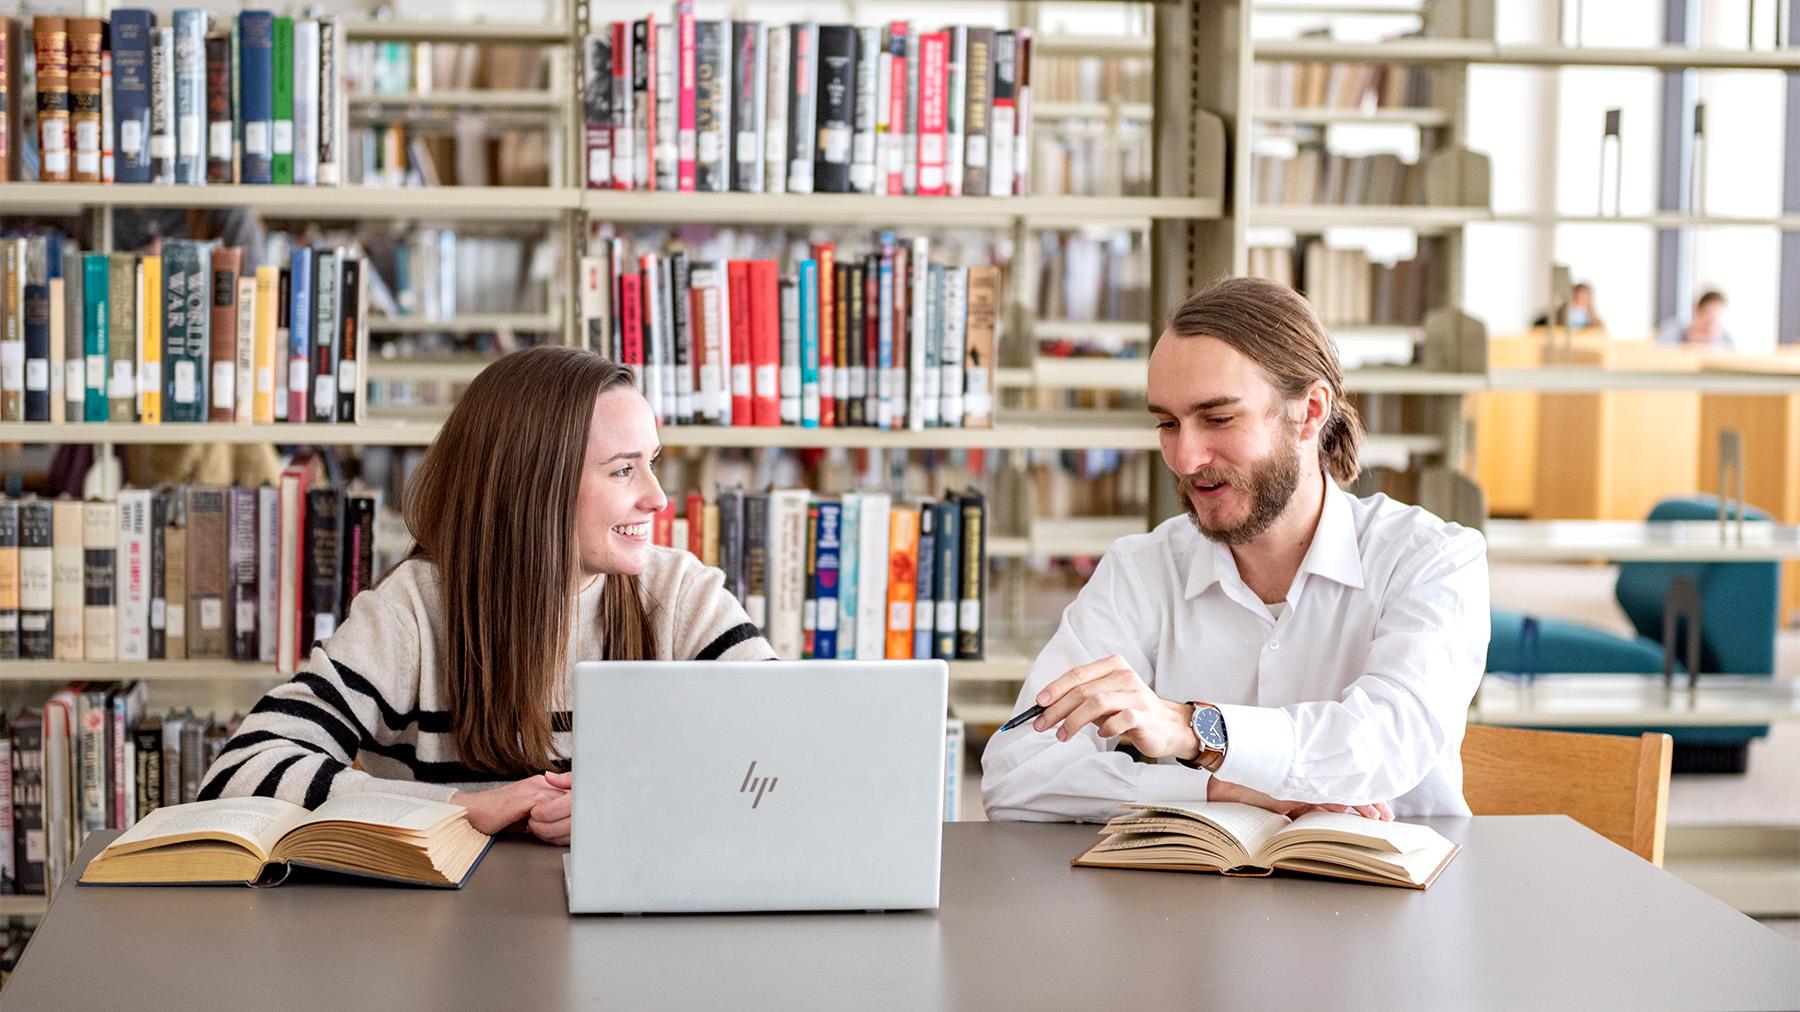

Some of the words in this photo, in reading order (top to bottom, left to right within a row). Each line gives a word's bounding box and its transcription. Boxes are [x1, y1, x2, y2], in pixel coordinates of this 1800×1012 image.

[167, 271, 186, 327] WAR
[187, 271, 204, 357] WORLD
[167, 337, 185, 355] II
[740, 760, 778, 809] hp
